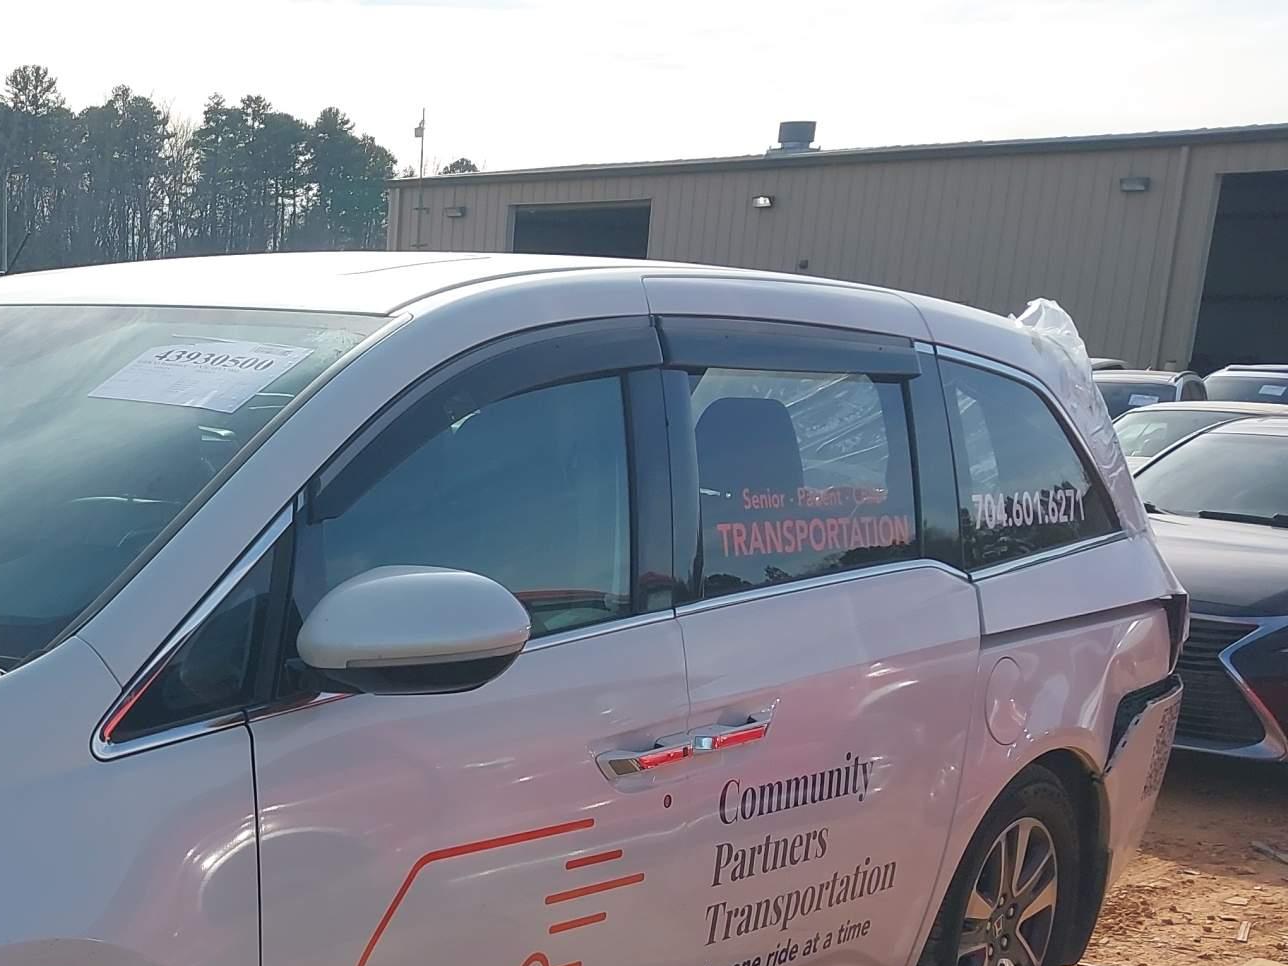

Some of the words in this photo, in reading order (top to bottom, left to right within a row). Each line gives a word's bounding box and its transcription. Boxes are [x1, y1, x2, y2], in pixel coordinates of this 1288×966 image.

[154, 350, 274, 371] 43930500
[743, 488, 785, 510] Senior
[972, 488, 1085, 530] 704.601.6271
[717, 515, 910, 557] TRANSPORTATION
[718, 751, 875, 824] Community
[712, 827, 829, 887] Partners
[705, 856, 898, 947] Transportation
[801, 931, 821, 957] at
[822, 931, 834, 949] a
[836, 917, 871, 945] time
